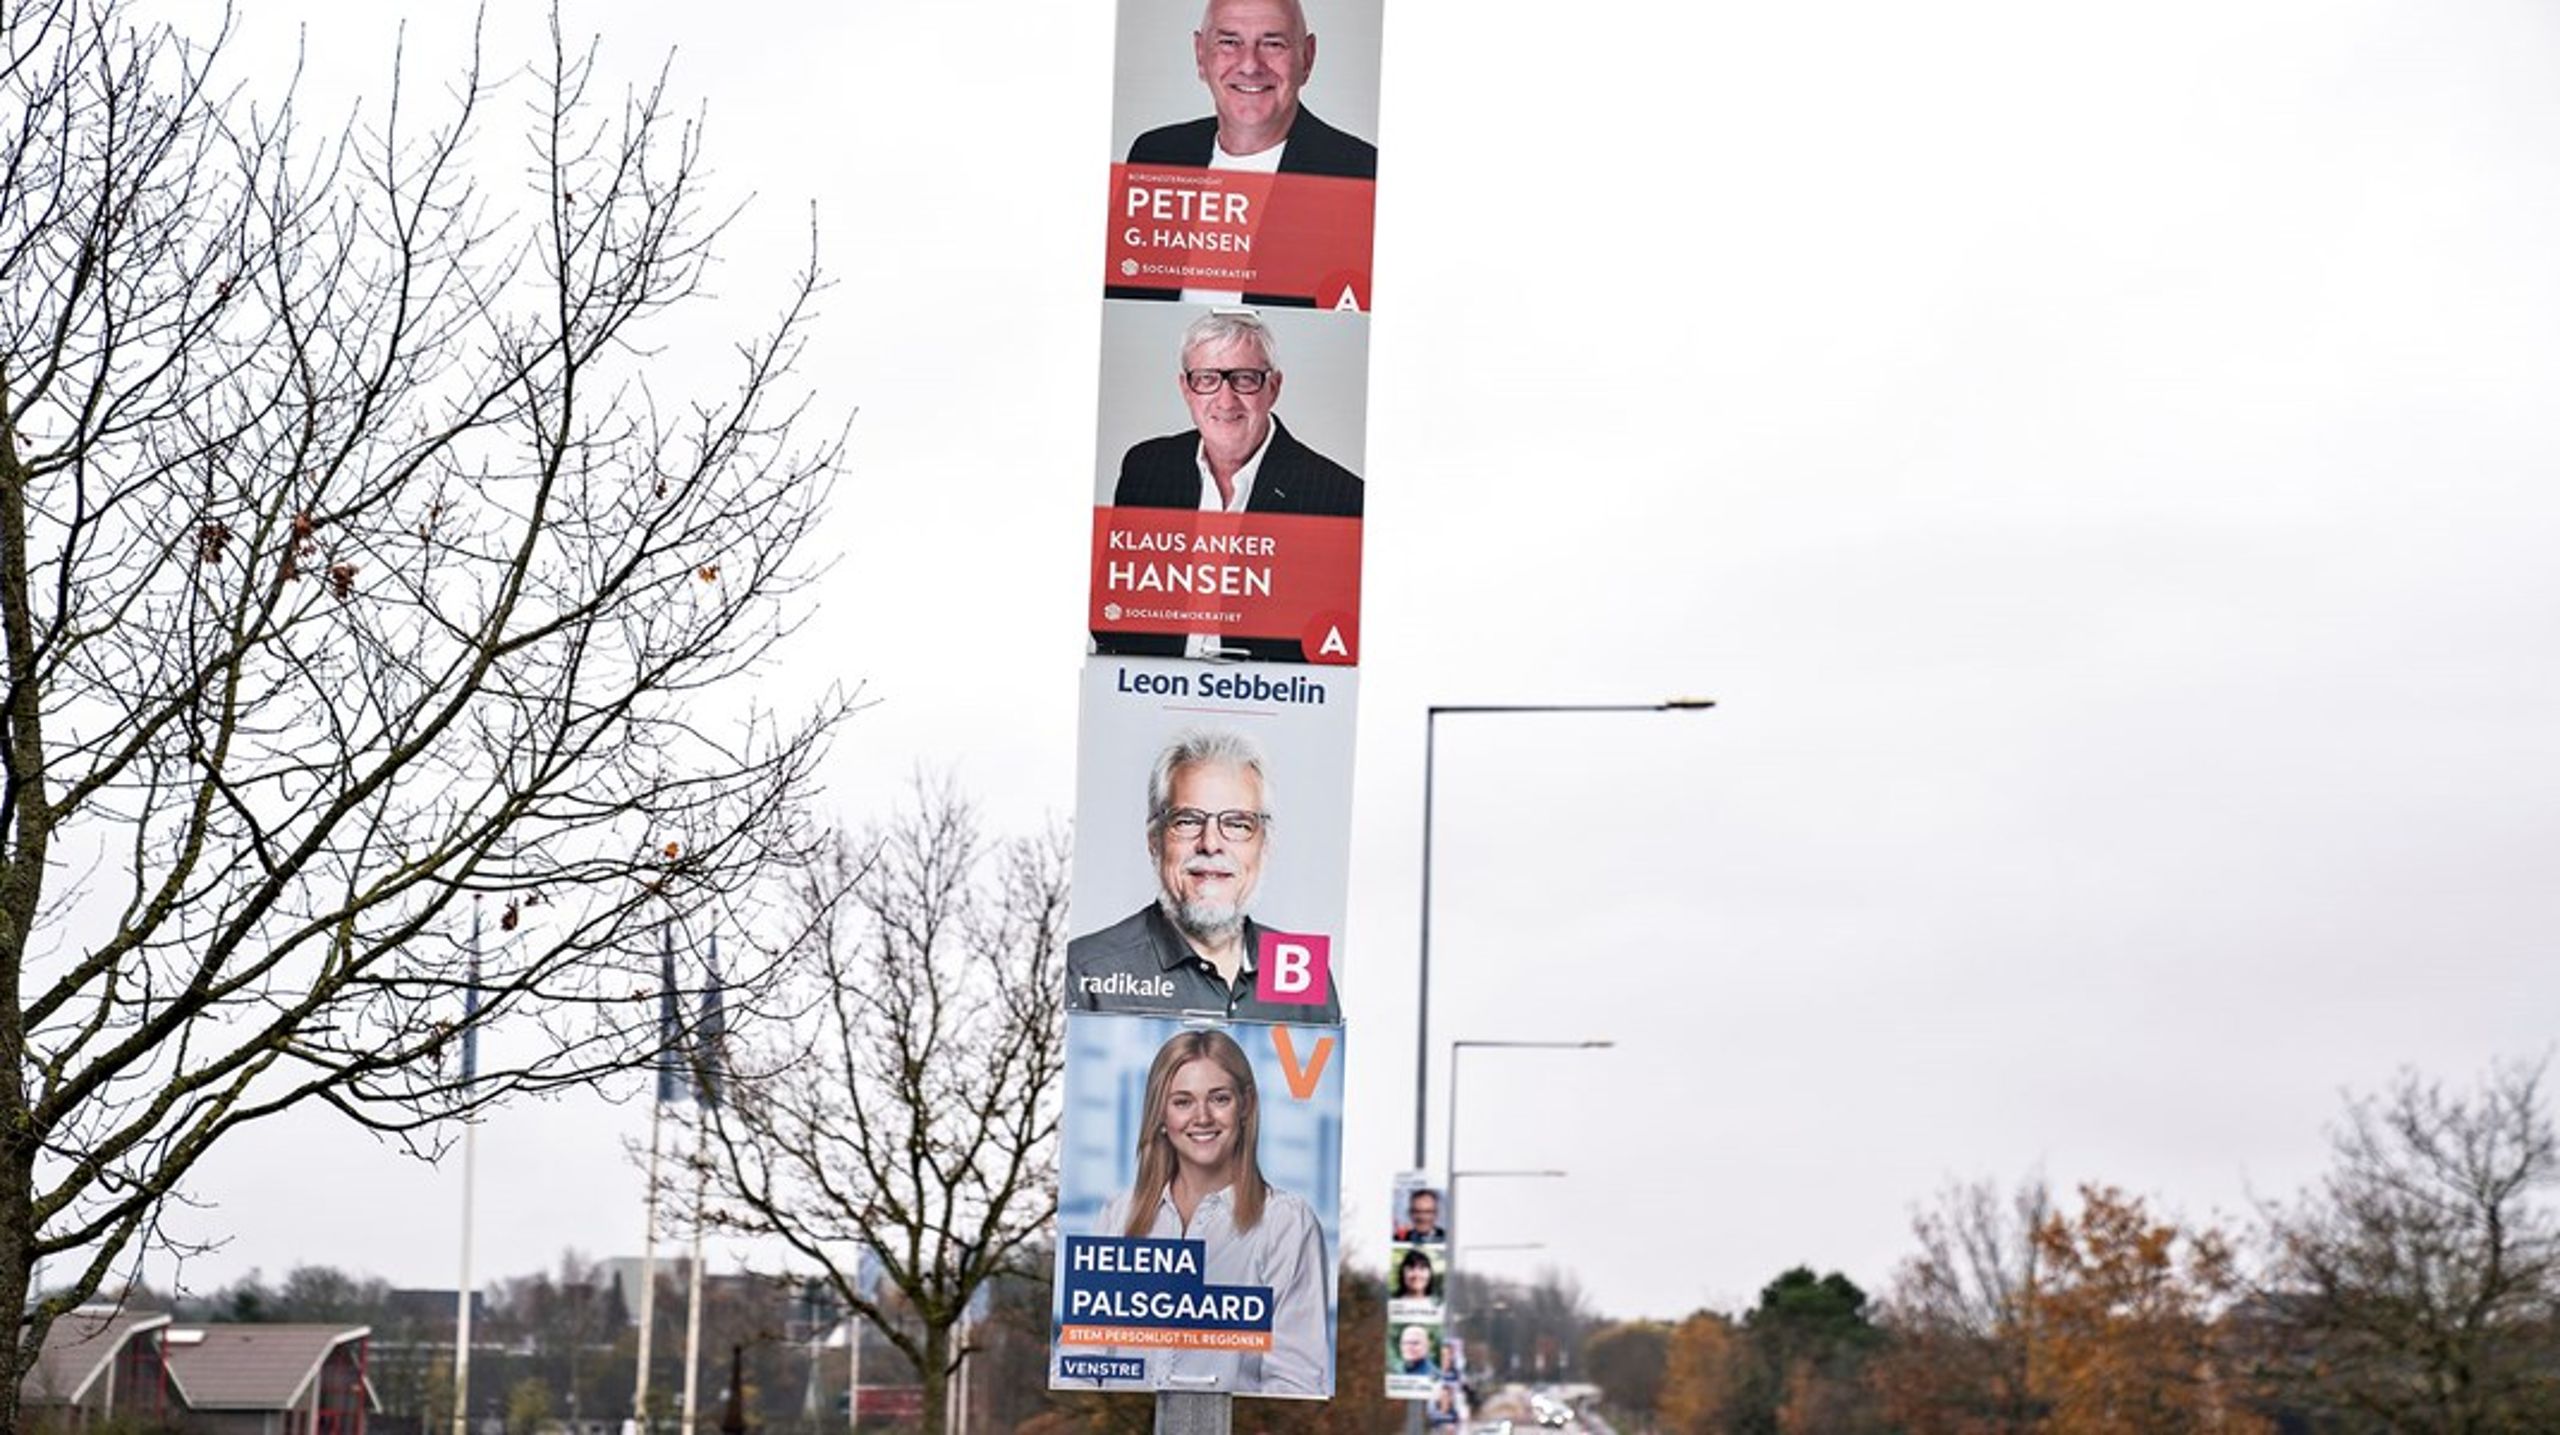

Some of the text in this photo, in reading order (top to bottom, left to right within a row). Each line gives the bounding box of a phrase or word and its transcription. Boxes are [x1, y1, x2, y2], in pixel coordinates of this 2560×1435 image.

[1127, 187, 1249, 223] PETER
[1124, 227, 1250, 252] G. HANSEN
[1142, 264, 1257, 279] SOCIALDEMOKRATIET
[1334, 283, 1360, 310] A
[1109, 531, 1275, 556] KLAUS ANKER
[1108, 561, 1271, 597] HANSEN
[1125, 609, 1242, 622] SOCIALDEMOKRATIET
[1319, 625, 1348, 656] A
[1117, 668, 1325, 703] Leon Sebbelin
[1274, 943, 1312, 993] B
[1079, 972, 1175, 998] radikale
[1270, 1023, 1335, 1100] V
[1074, 1245, 1197, 1275] HELENA
[1072, 1290, 1265, 1321] PALSGAARD
[1069, 1329, 1265, 1346] STEM PERSONLIGT TIL REGIONEN
[1065, 1360, 1141, 1377] VENSTRE
